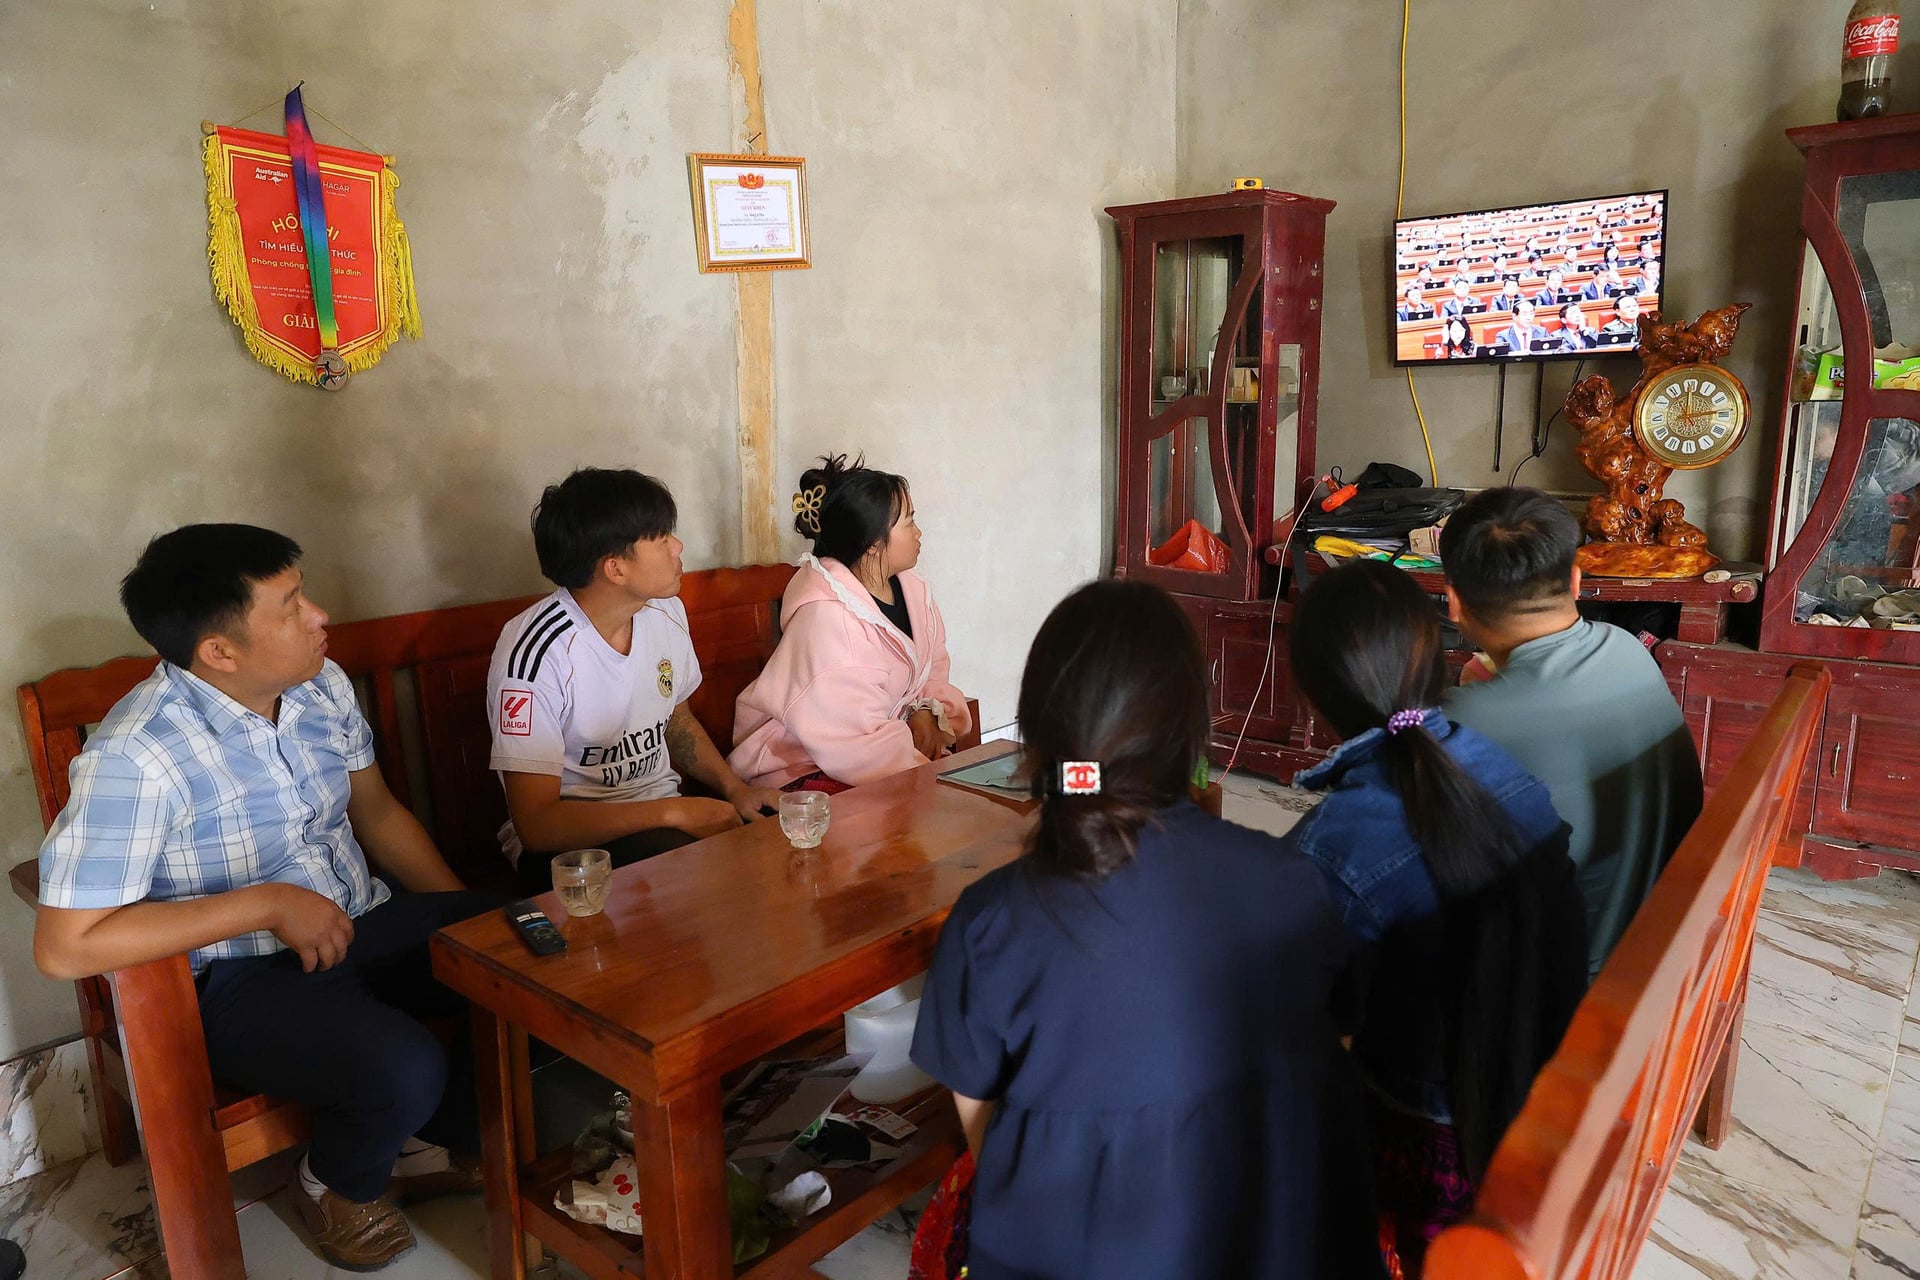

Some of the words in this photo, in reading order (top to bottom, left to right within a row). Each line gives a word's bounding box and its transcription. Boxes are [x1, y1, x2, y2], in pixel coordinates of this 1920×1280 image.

[1849, 16, 1899, 43] Coca-Cola
[255, 167, 288, 178] Australian
[323, 181, 350, 192] HAGAR
[272, 212, 302, 233] HỘ
[326, 226, 339, 240] HI
[252, 257, 278, 268] Phòng
[503, 720, 527, 729] LALIGA
[579, 713, 673, 767] Emirat
[602, 764, 622, 787] FLY
[625, 748, 662, 782] BETTE
